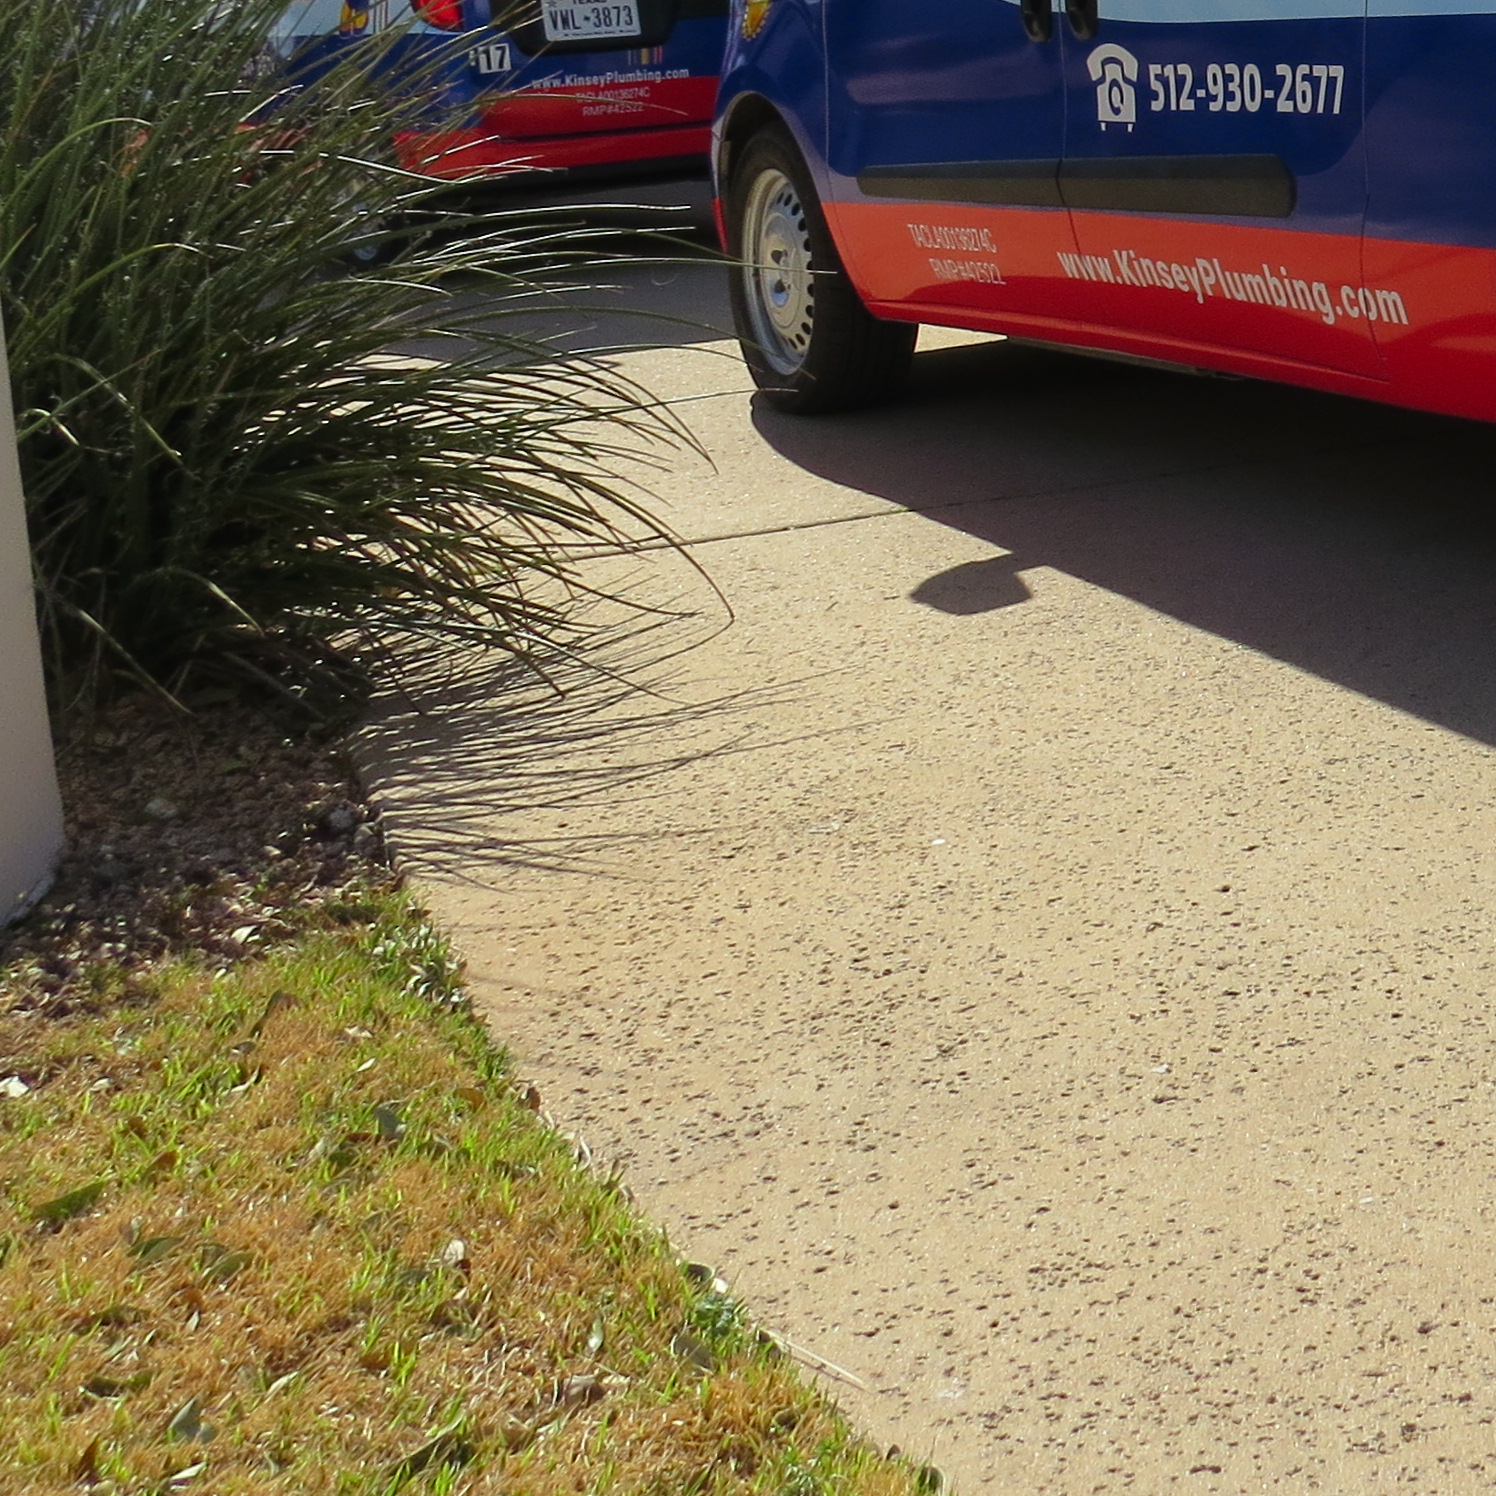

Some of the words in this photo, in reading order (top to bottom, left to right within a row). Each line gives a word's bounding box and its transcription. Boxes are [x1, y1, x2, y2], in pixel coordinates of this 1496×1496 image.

[532, 68, 690, 90] www.KinseyPlumbing.com
[1149, 62, 1345, 116] 512-930-2677
[1056, 249, 1409, 326] www.KinseyPlumbing.com
